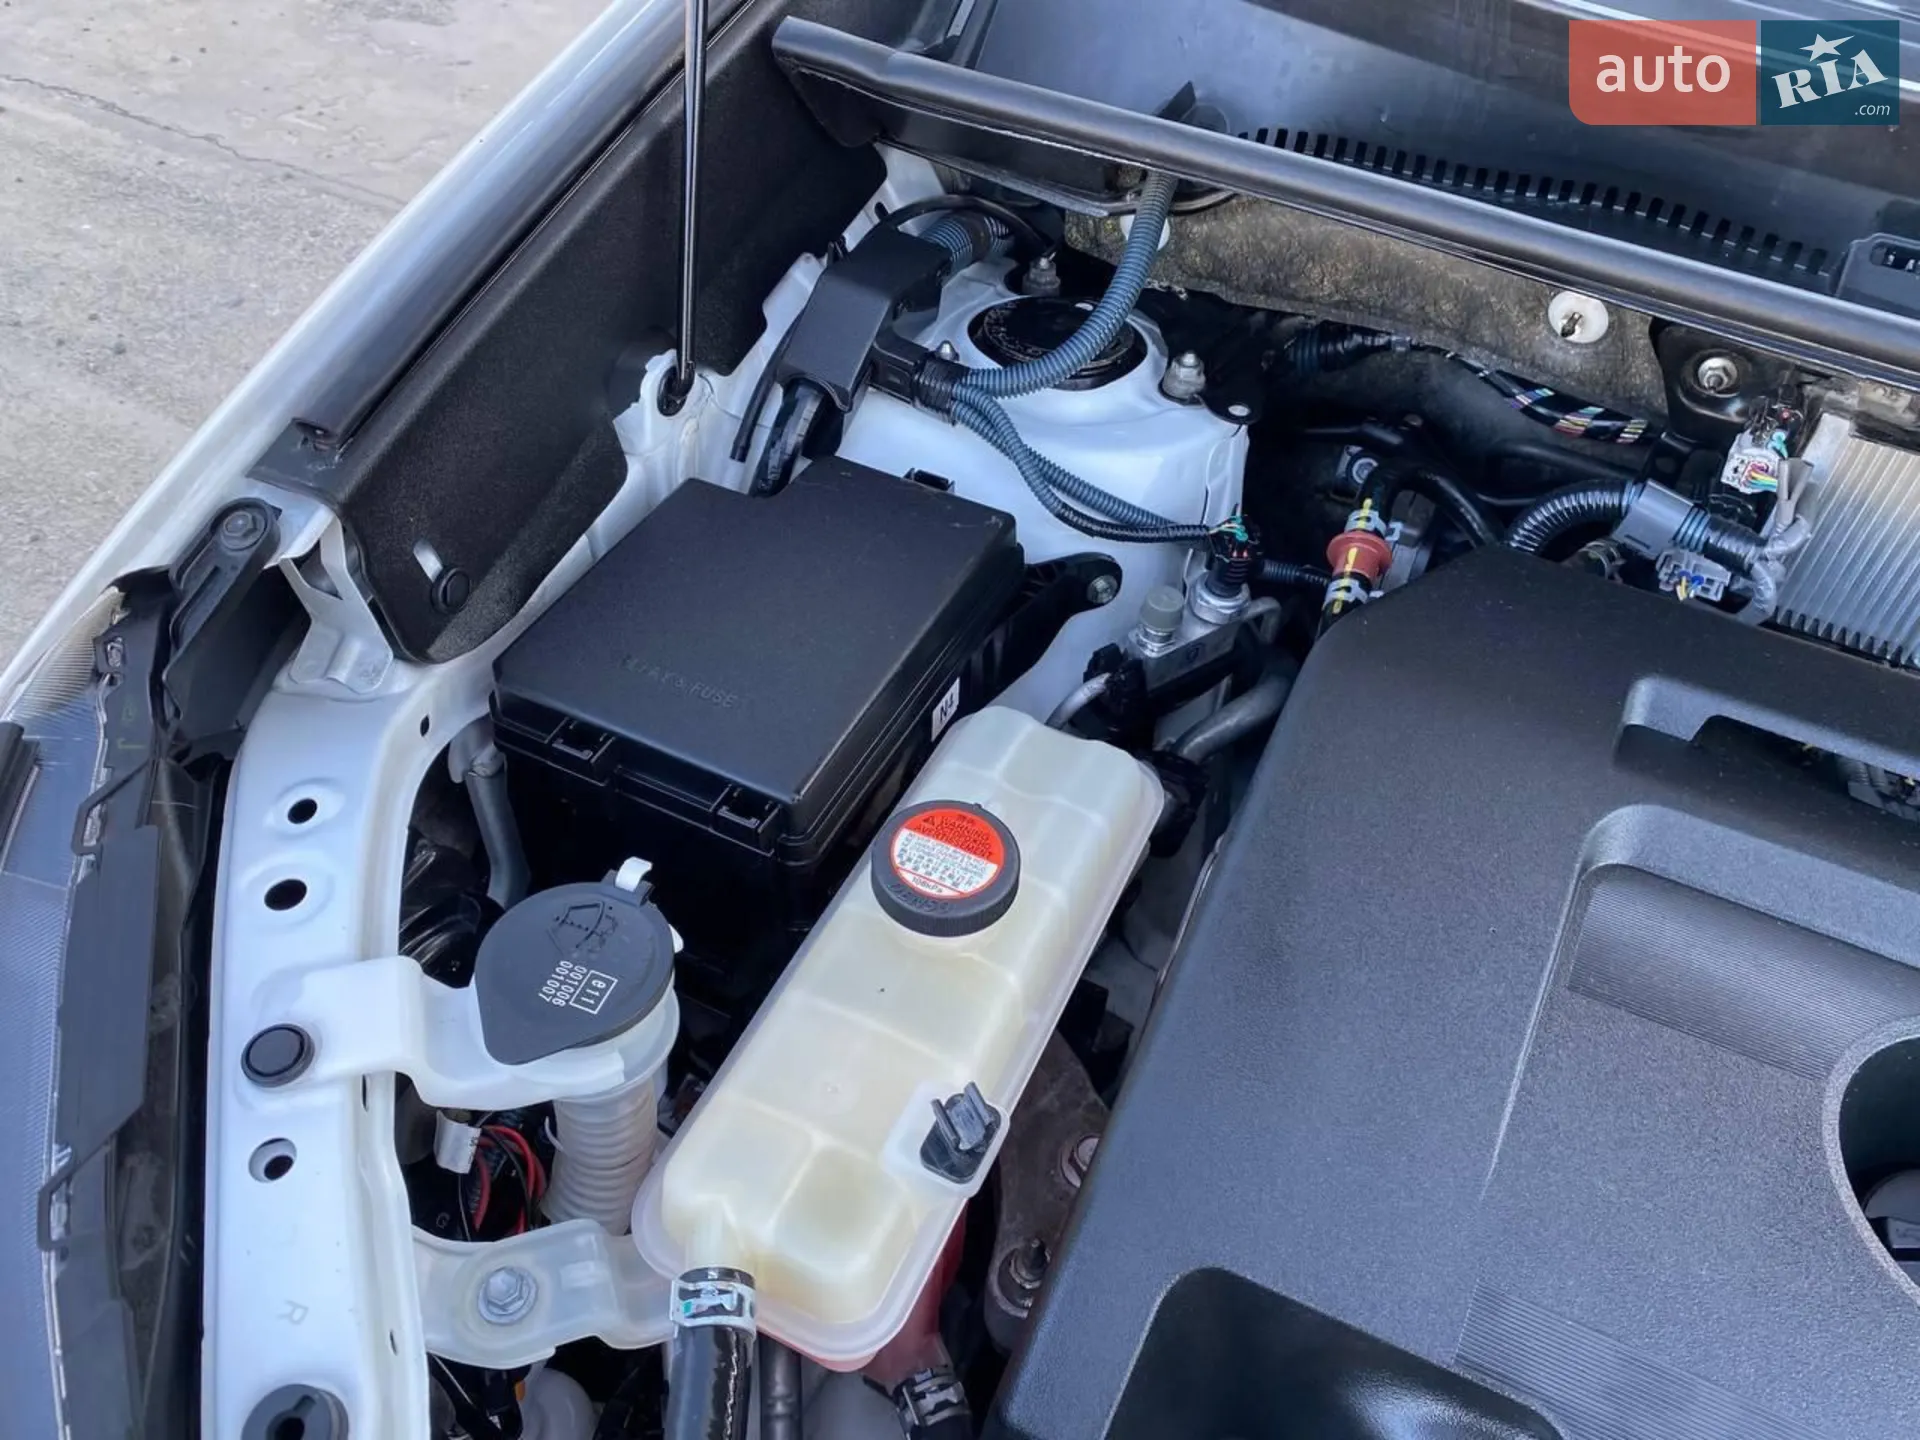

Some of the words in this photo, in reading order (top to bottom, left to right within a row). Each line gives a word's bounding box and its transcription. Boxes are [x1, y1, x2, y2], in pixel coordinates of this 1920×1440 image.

[940, 816, 989, 841] WARNING
[538, 960, 574, 1002] 001007
[581, 979, 607, 1006] e11
